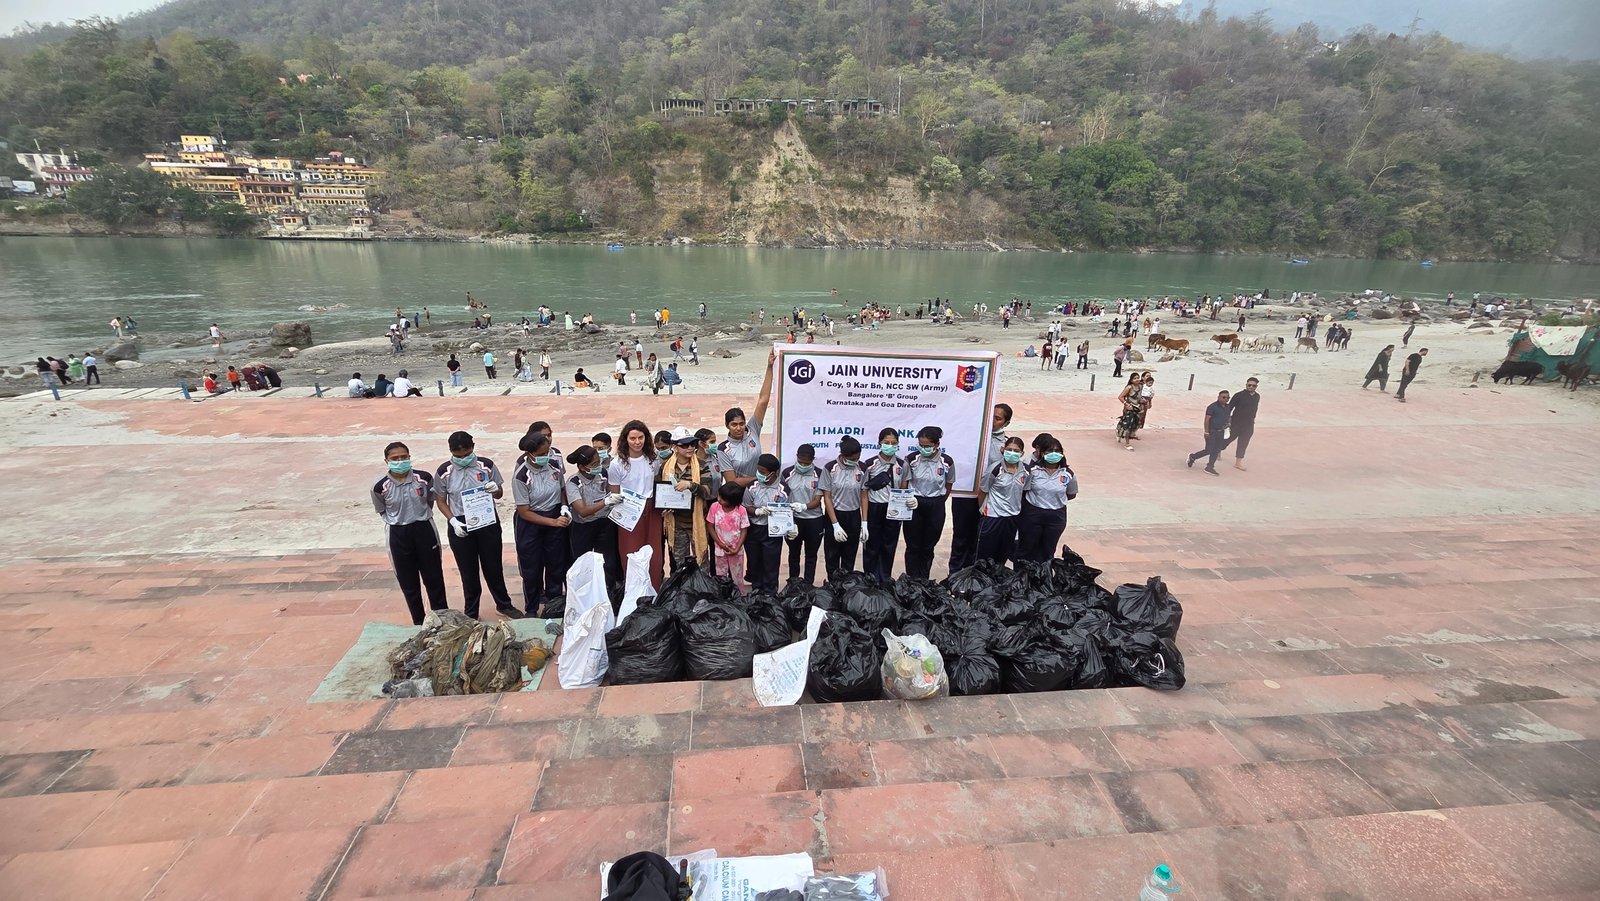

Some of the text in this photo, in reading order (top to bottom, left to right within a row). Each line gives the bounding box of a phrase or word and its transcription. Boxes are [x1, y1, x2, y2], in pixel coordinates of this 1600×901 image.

[828, 364, 942, 379] JAIN UNIVERSITY
[827, 381, 843, 389] Coy,
[854, 381, 869, 389] Kar
[870, 382, 884, 390] Bn,
[886, 383, 904, 391] NCC
[906, 383, 919, 391] SW
[920, 384, 948, 392] (Army)
[826, 399, 864, 407] Karnataka
[812, 426, 865, 435] HIMADRI
